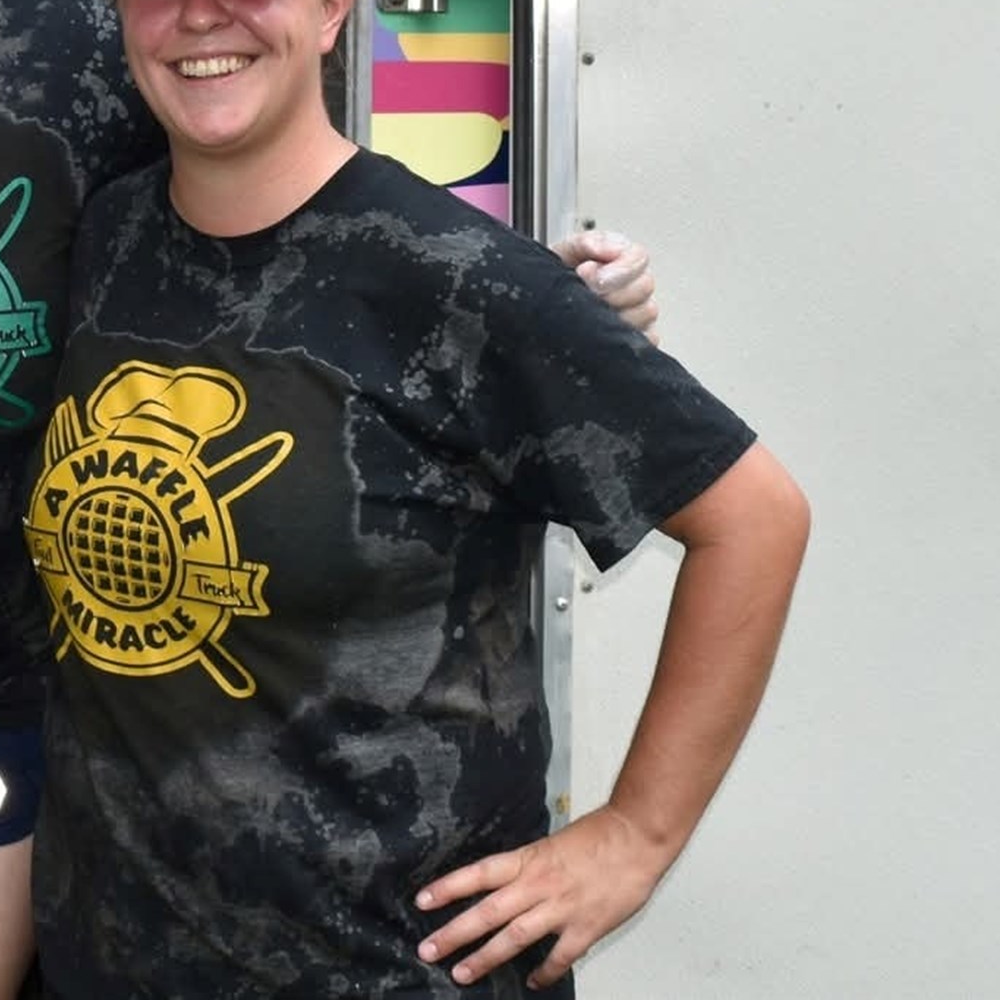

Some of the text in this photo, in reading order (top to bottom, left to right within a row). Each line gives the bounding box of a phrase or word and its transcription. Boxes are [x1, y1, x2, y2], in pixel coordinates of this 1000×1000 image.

[45, 450, 210, 546] A WAFFLE
[191, 573, 242, 600] Truck
[61, 588, 197, 652] MIRACLE
